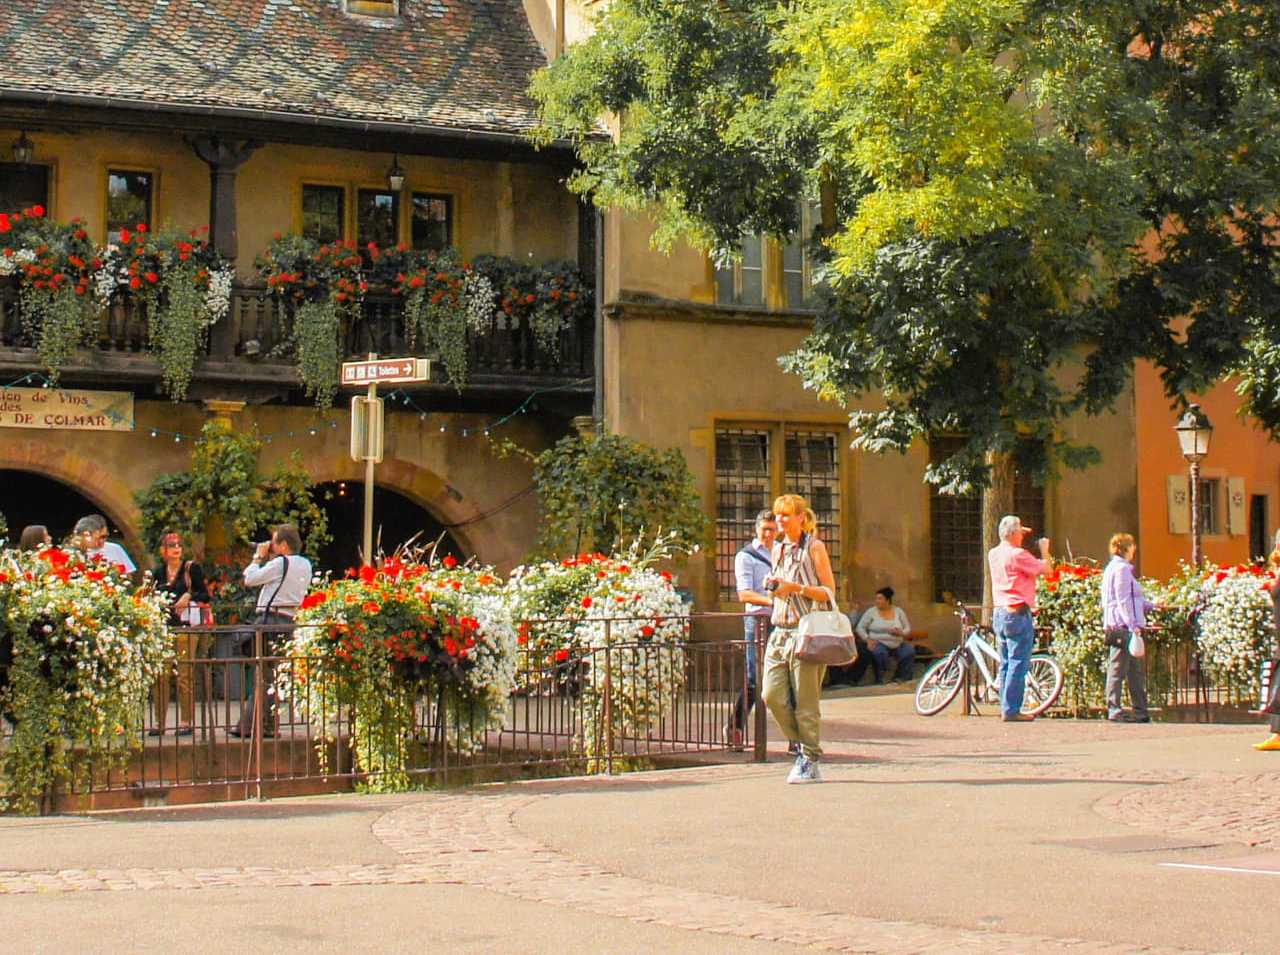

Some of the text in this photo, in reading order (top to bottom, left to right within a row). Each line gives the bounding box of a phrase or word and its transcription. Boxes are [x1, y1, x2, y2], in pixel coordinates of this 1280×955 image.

[31, 392, 48, 403] de
[0, 402, 22, 413] des
[14, 412, 33, 424] DE
[44, 413, 106, 426] COLMAR
